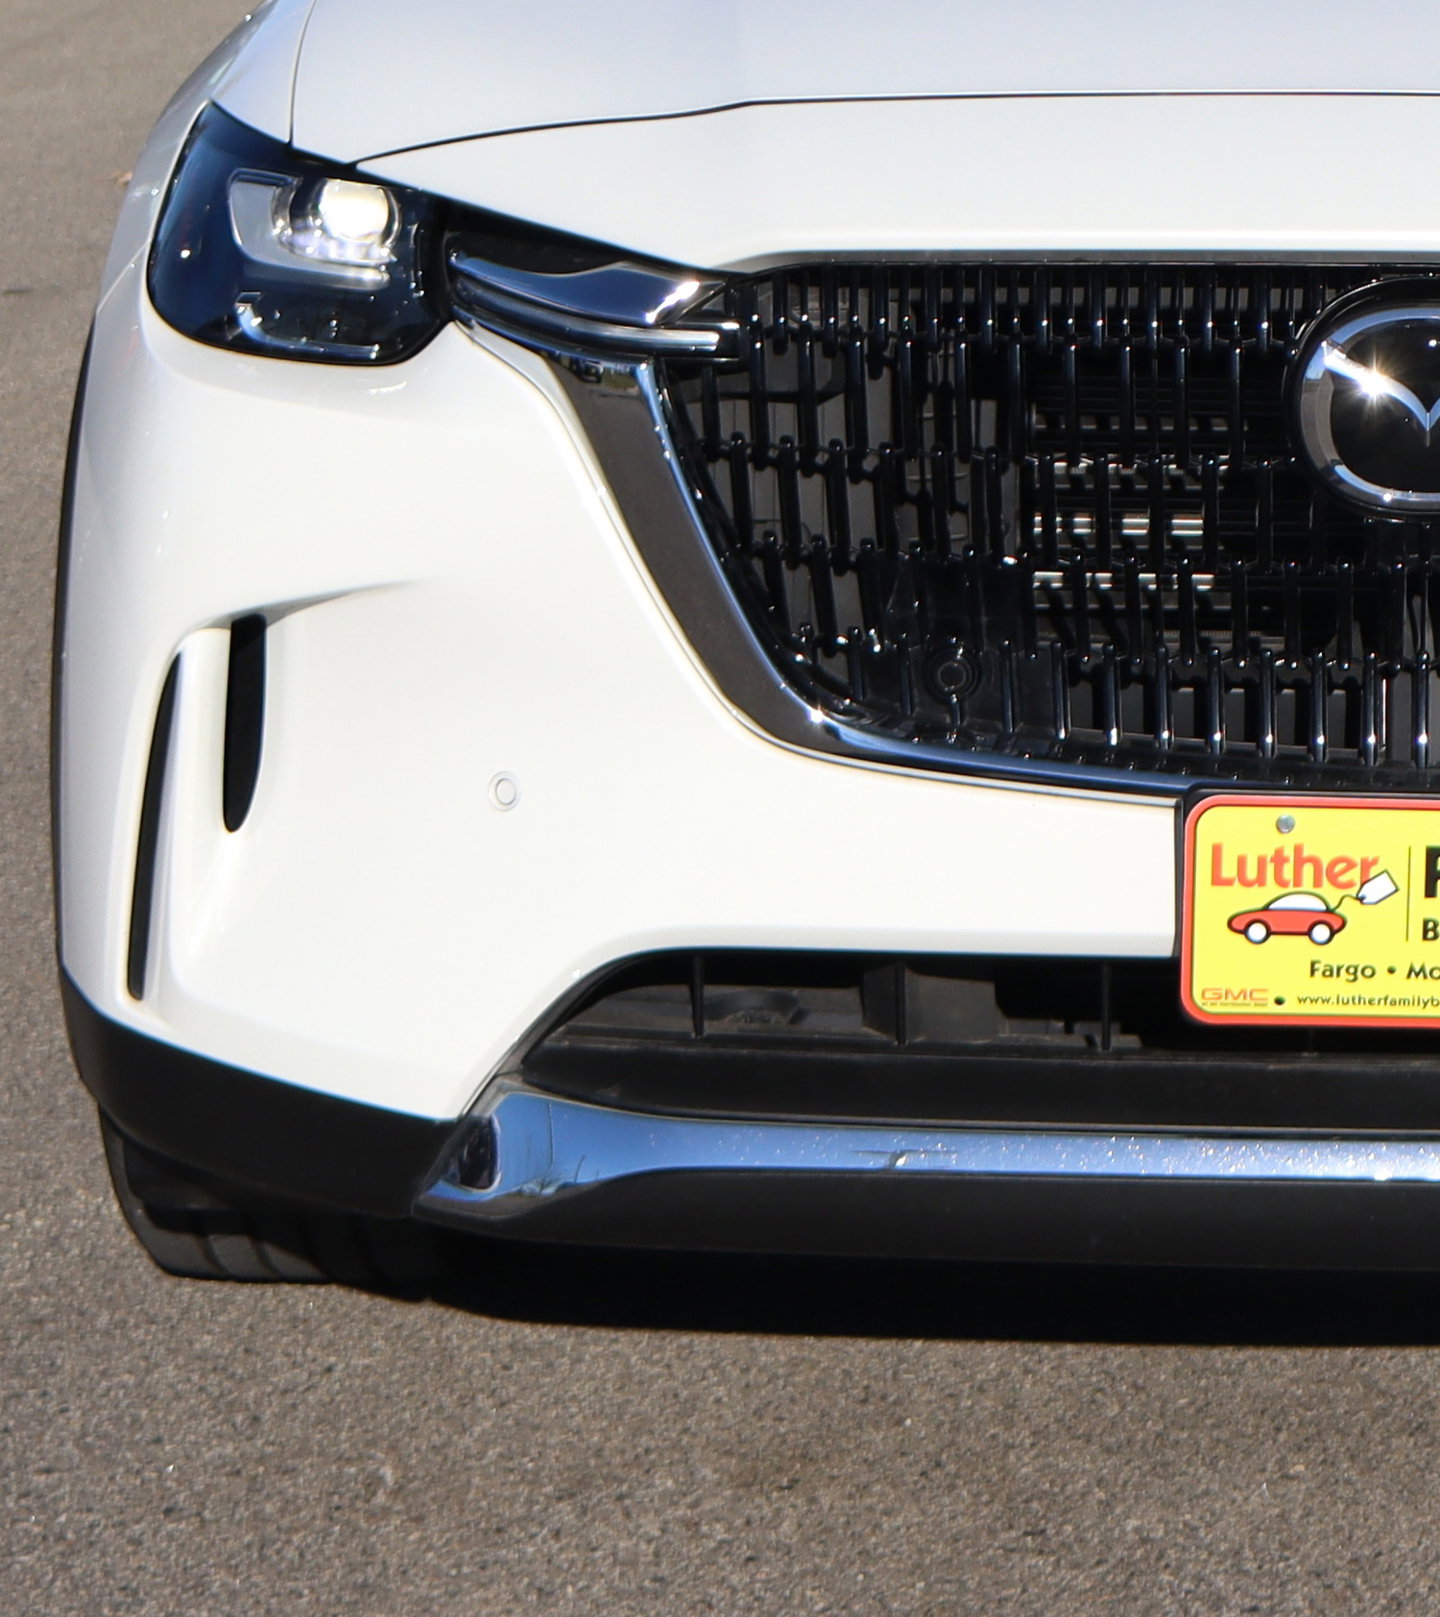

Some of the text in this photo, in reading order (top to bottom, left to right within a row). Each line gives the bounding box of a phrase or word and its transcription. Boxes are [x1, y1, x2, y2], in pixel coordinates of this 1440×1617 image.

[1210, 841, 1380, 890] Luther
[1309, 959, 1377, 983] Fargo
[1201, 987, 1269, 1001] GMC
